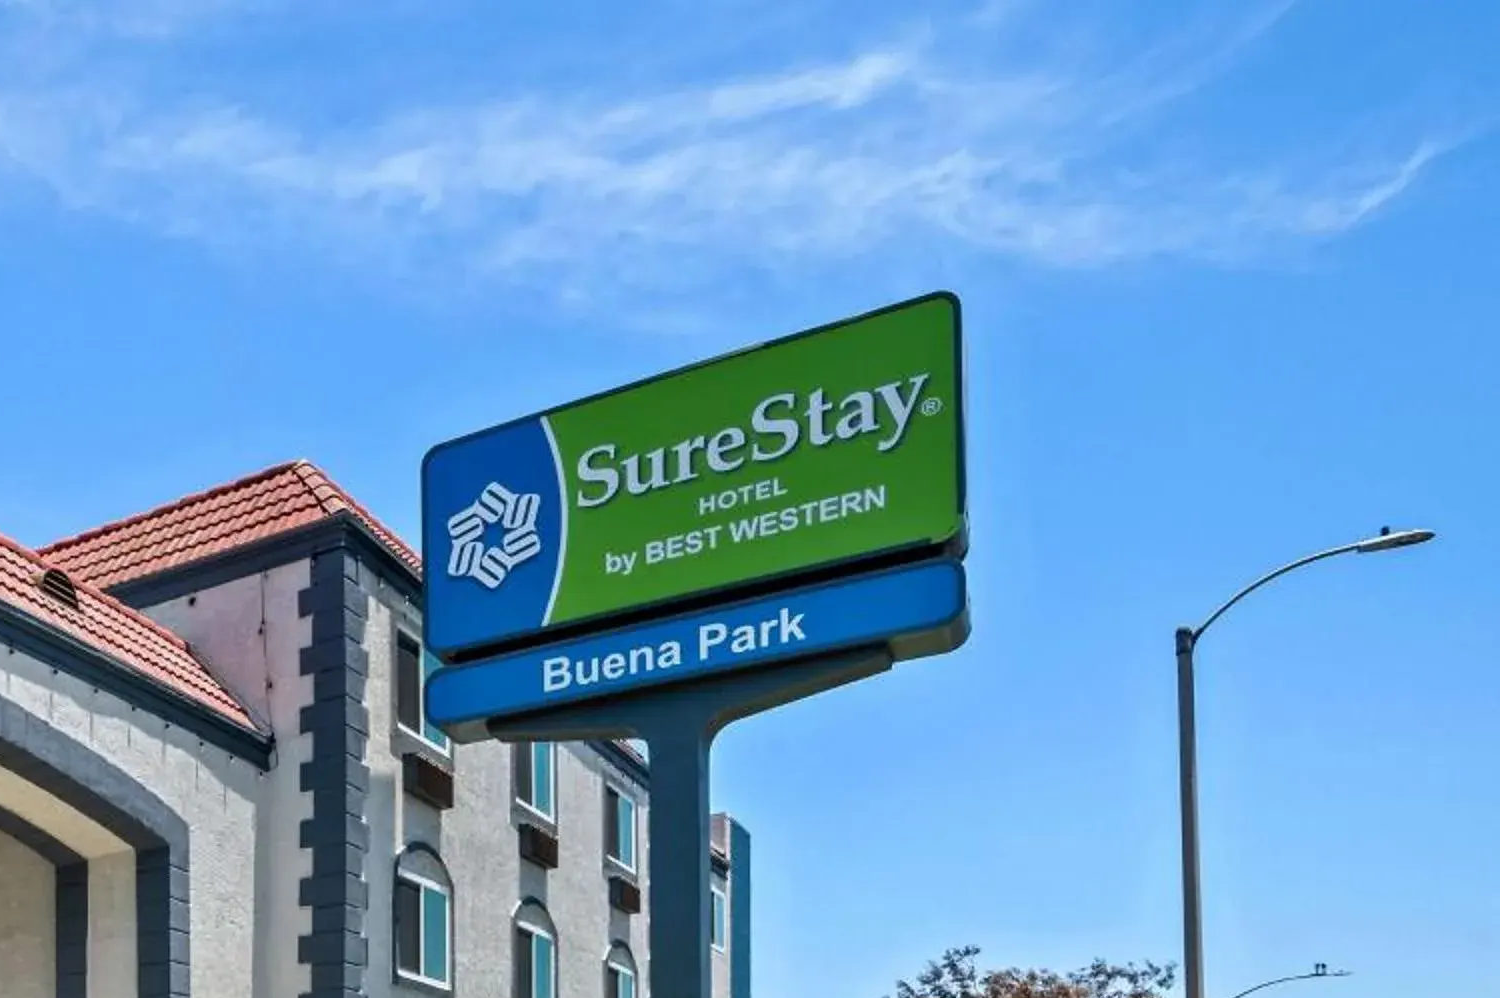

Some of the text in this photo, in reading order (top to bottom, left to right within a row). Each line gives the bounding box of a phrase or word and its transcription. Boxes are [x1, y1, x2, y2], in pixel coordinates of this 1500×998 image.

[605, 485, 886, 574] by BEST WESTERN
[699, 478, 788, 515] HOTEL
[542, 607, 806, 692] Buena Park
